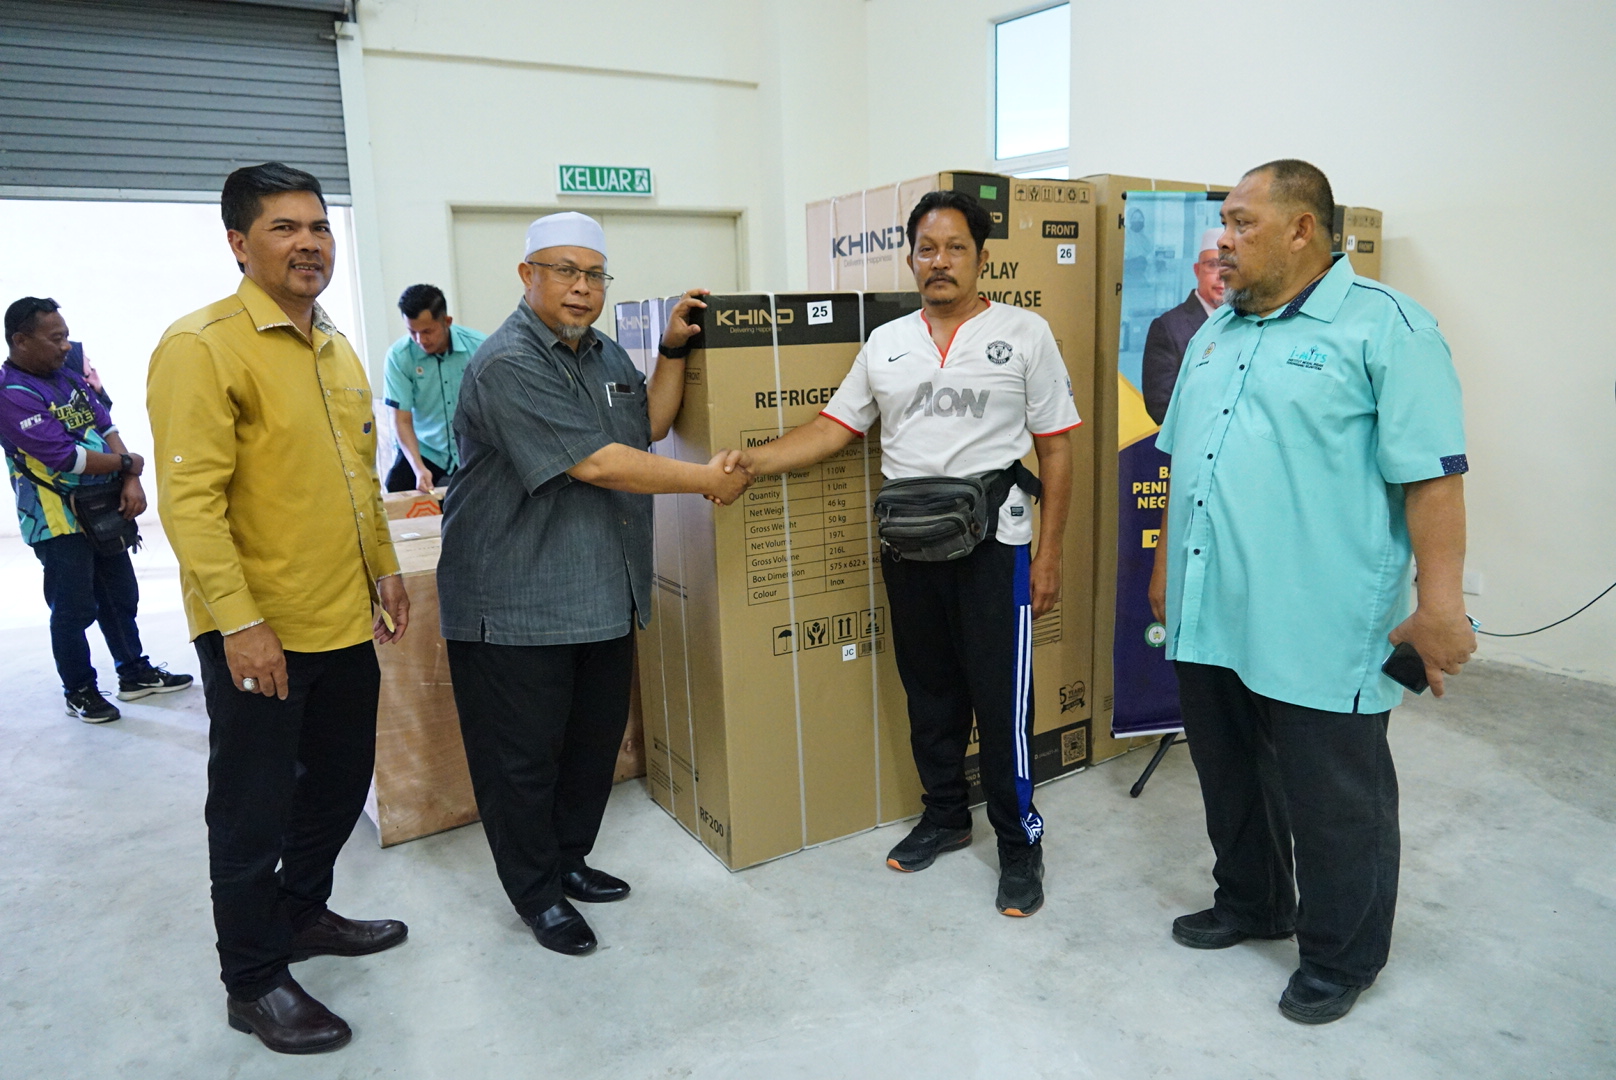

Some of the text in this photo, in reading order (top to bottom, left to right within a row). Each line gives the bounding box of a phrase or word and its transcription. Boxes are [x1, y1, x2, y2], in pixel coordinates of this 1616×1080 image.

[562, 167, 632, 192] KELUAR
[1045, 224, 1076, 236] FRONT
[832, 225, 905, 259] KHIND
[1060, 248, 1072, 259] 26
[812, 305, 828, 318] 25
[716, 308, 795, 326] KHIND
[729, 326, 755, 334] Delivering
[904, 381, 991, 420] AON
[788, 471, 810, 479] Power
[827, 466, 846, 475] 110W
[832, 482, 848, 491] Unit
[748, 490, 781, 501] Quantity
[838, 498, 846, 508] kg
[749, 509, 763, 517] Net
[828, 514, 847, 524] 50 kg
[750, 521, 797, 534] Gross Weiht
[829, 530, 845, 539] 197L
[751, 542, 764, 551] Net
[829, 546, 846, 555] 216L
[751, 558, 772, 567] Gross
[830, 561, 843, 571] 575
[848, 558, 861, 568] 622
[752, 574, 766, 583] Box
[830, 578, 845, 586] Inox
[753, 589, 778, 600] Colour
[844, 648, 855, 657] JC
[1059, 686, 1068, 705] 5
[699, 806, 725, 838] RF200
